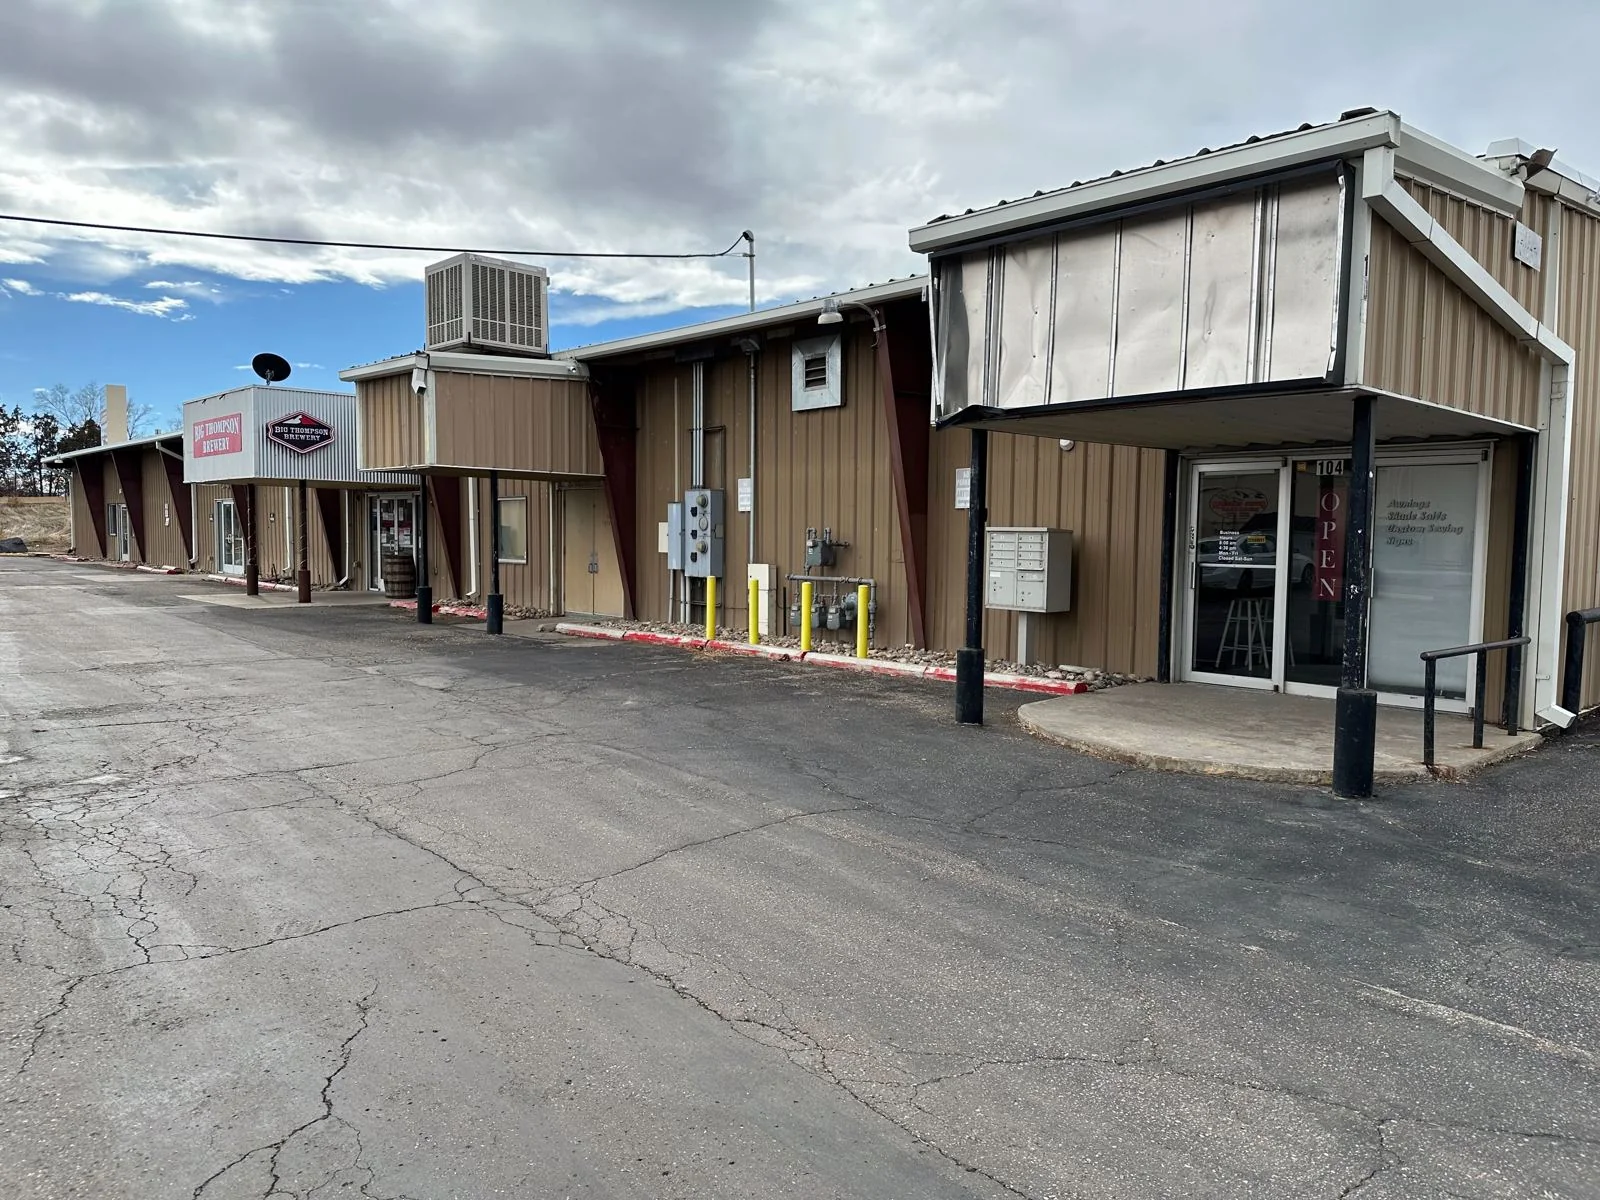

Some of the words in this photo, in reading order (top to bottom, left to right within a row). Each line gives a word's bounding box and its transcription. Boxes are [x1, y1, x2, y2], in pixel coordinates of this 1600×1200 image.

[195, 424, 204, 441] BIG
[205, 417, 239, 436] THOMPSON
[290, 426, 328, 435] THOMPSON
[284, 433, 321, 441] BREWERY
[202, 437, 230, 454] BREWERY
[1319, 461, 1342, 474] 104
[1319, 492, 1340, 597] OPEN
